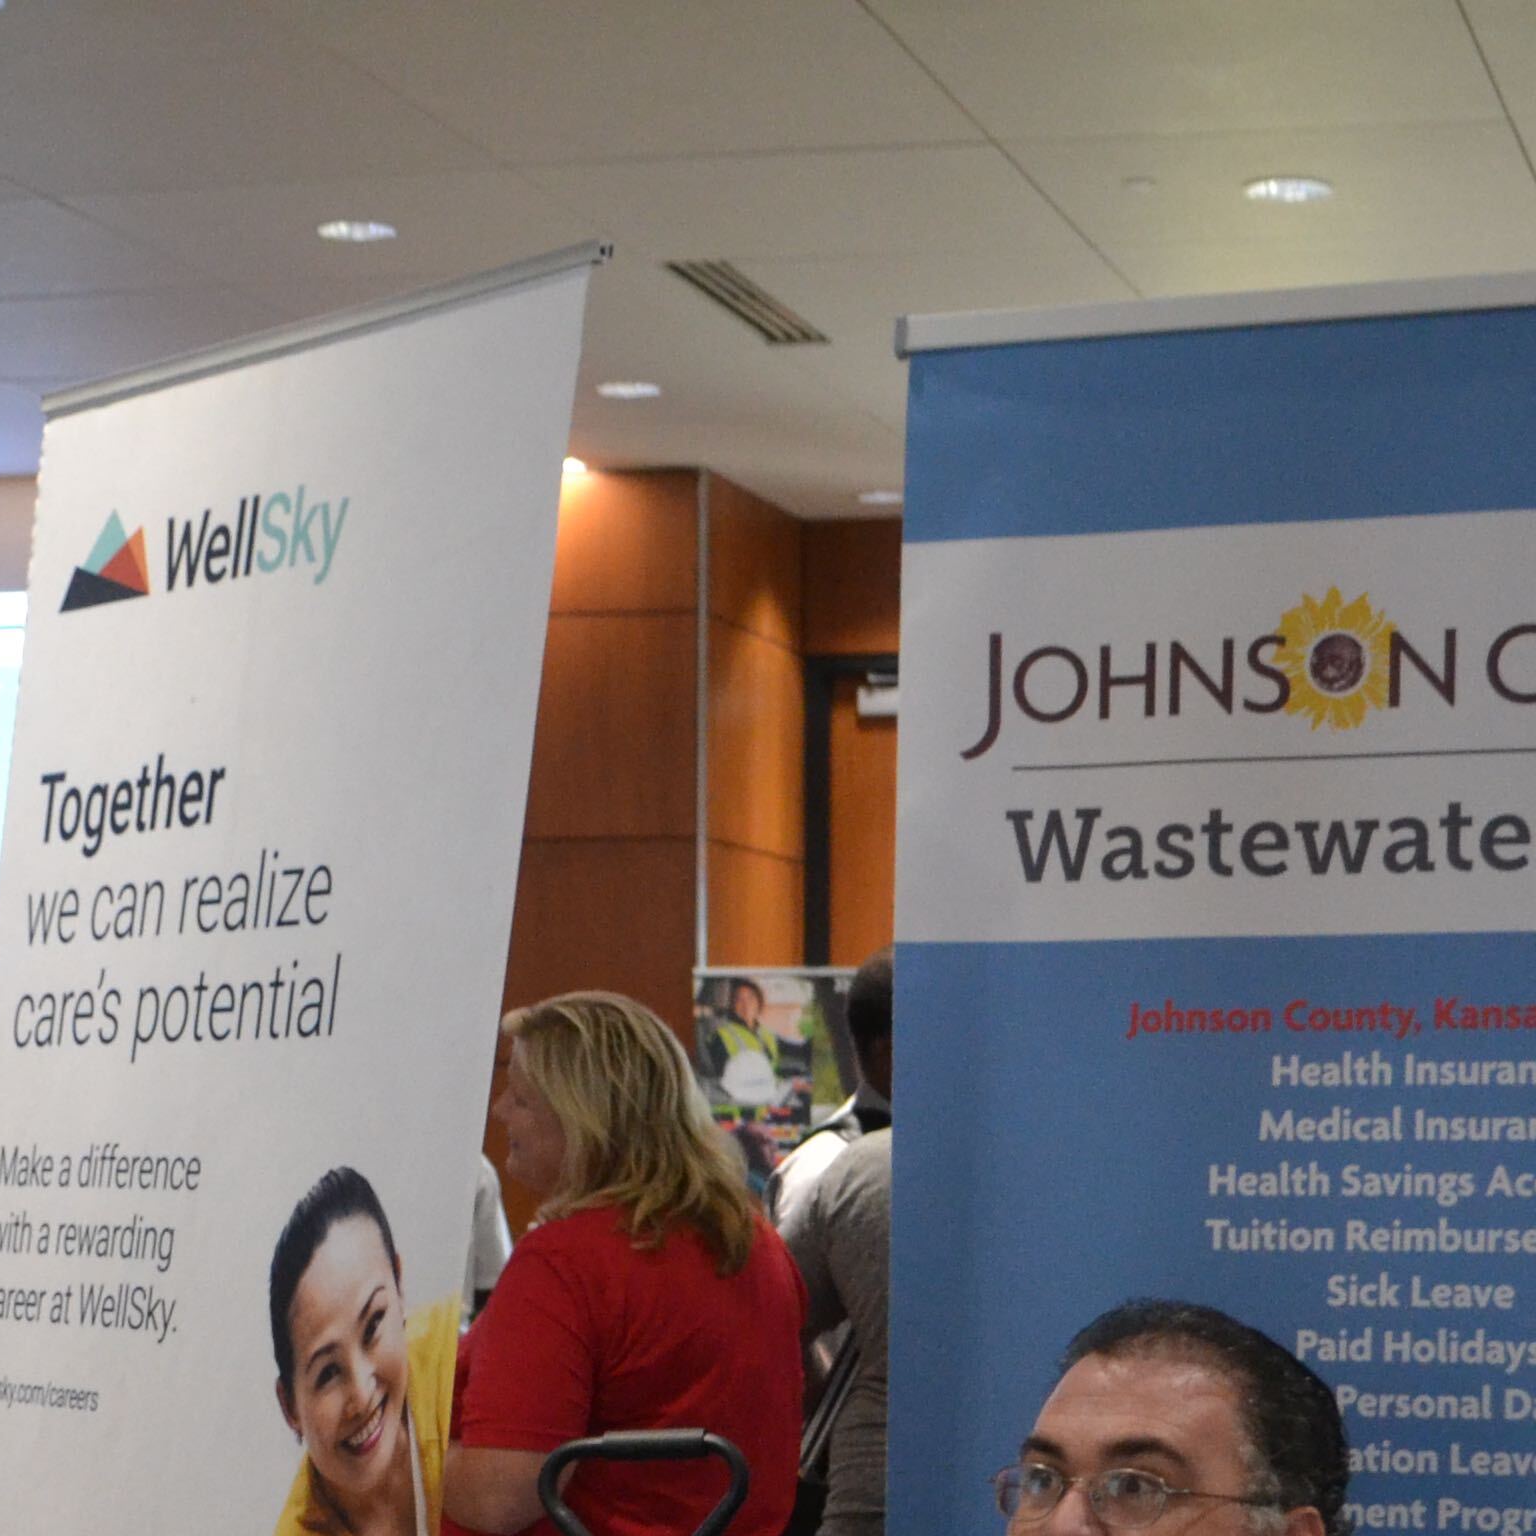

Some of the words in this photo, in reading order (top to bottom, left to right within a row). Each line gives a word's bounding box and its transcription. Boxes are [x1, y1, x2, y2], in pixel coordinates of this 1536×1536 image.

[166, 485, 349, 591] WellSky
[960, 624, 1457, 760] JOHNSON
[41, 754, 224, 856] Together
[27, 891, 76, 946] we
[91, 878, 166, 940] can
[179, 850, 333, 934] realize
[13, 969, 122, 1049] care's
[132, 953, 342, 1062] potential
[1126, 1000, 1271, 1040] Johnson
[1282, 999, 1422, 1040] County,
[1270, 1051, 1391, 1087] Health
[1258, 1106, 1402, 1143] Medical
[58, 1158, 71, 1189] a
[76, 1144, 201, 1191] difference
[1208, 1162, 1329, 1198] Health
[1341, 1164, 1473, 1208] Savings
[37, 1224, 50, 1256] a
[56, 1217, 174, 1272] rewarding
[1205, 1217, 1334, 1253] Tuition
[51, 1288, 71, 1324] at
[77, 1284, 178, 1343] WellSky.
[1326, 1274, 1400, 1307] Sick
[1410, 1276, 1514, 1309] Leave
[1295, 1329, 1373, 1364] Paid
[1336, 1385, 1491, 1422] Personal
[1347, 1440, 1438, 1475] ation
